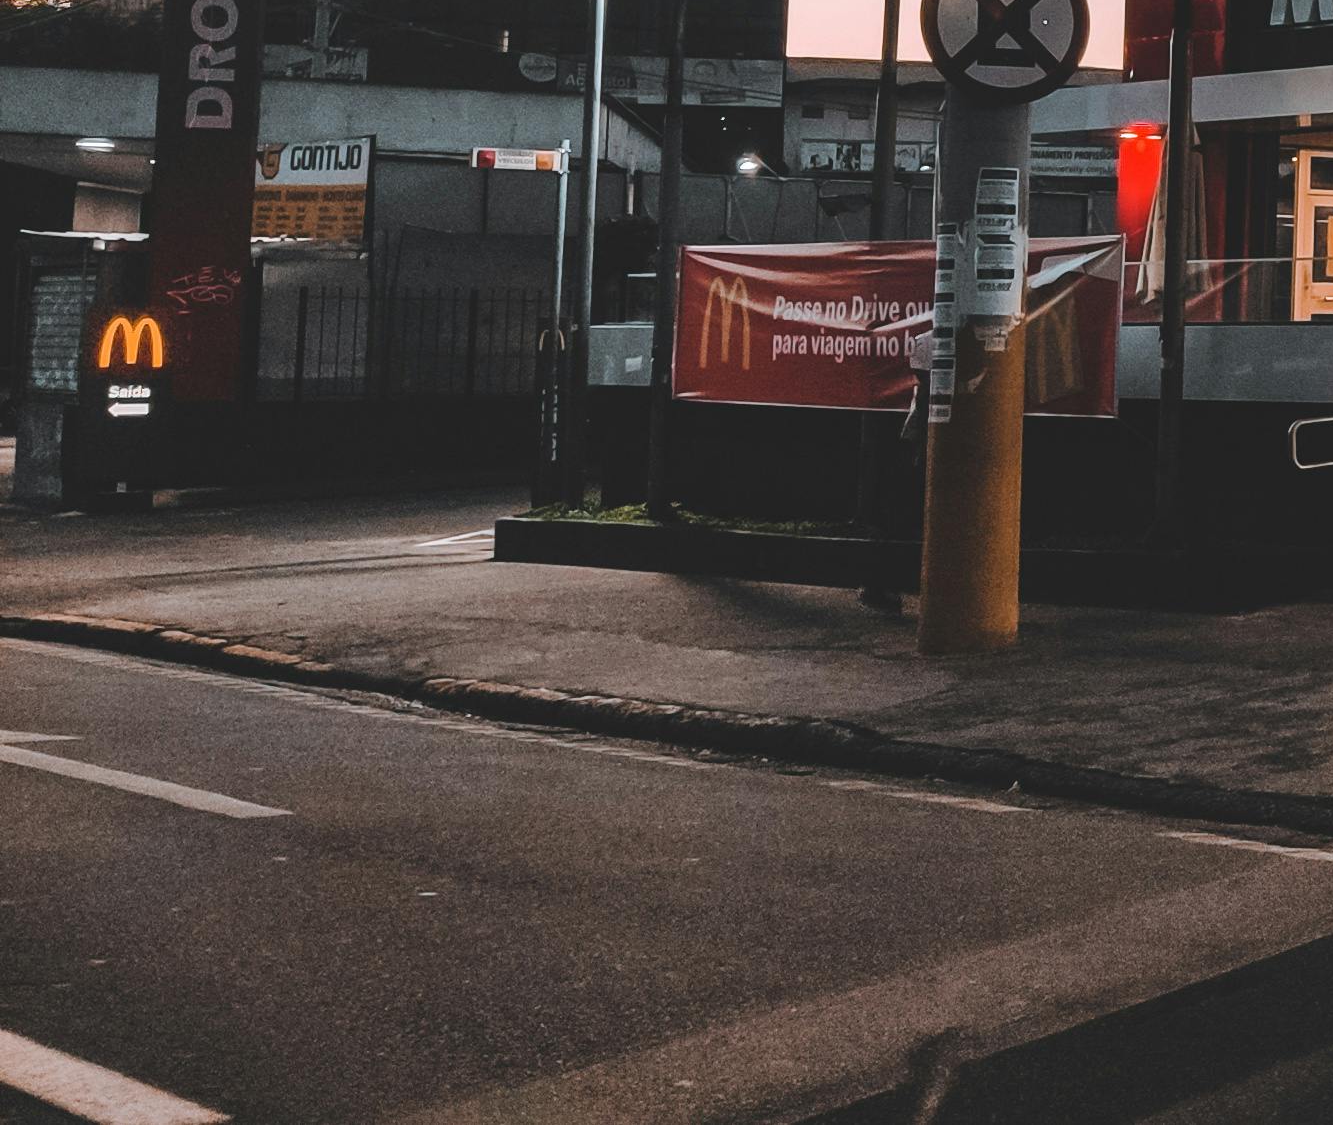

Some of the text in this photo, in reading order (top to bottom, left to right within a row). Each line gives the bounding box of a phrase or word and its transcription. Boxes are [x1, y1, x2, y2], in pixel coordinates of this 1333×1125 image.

[290, 144, 362, 171] GONTIJO
[773, 295, 822, 321] Passe
[824, 301, 847, 321] no
[851, 294, 900, 322] Drive
[772, 333, 808, 362] para
[811, 327, 872, 364] viagem
[876, 335, 900, 357] no
